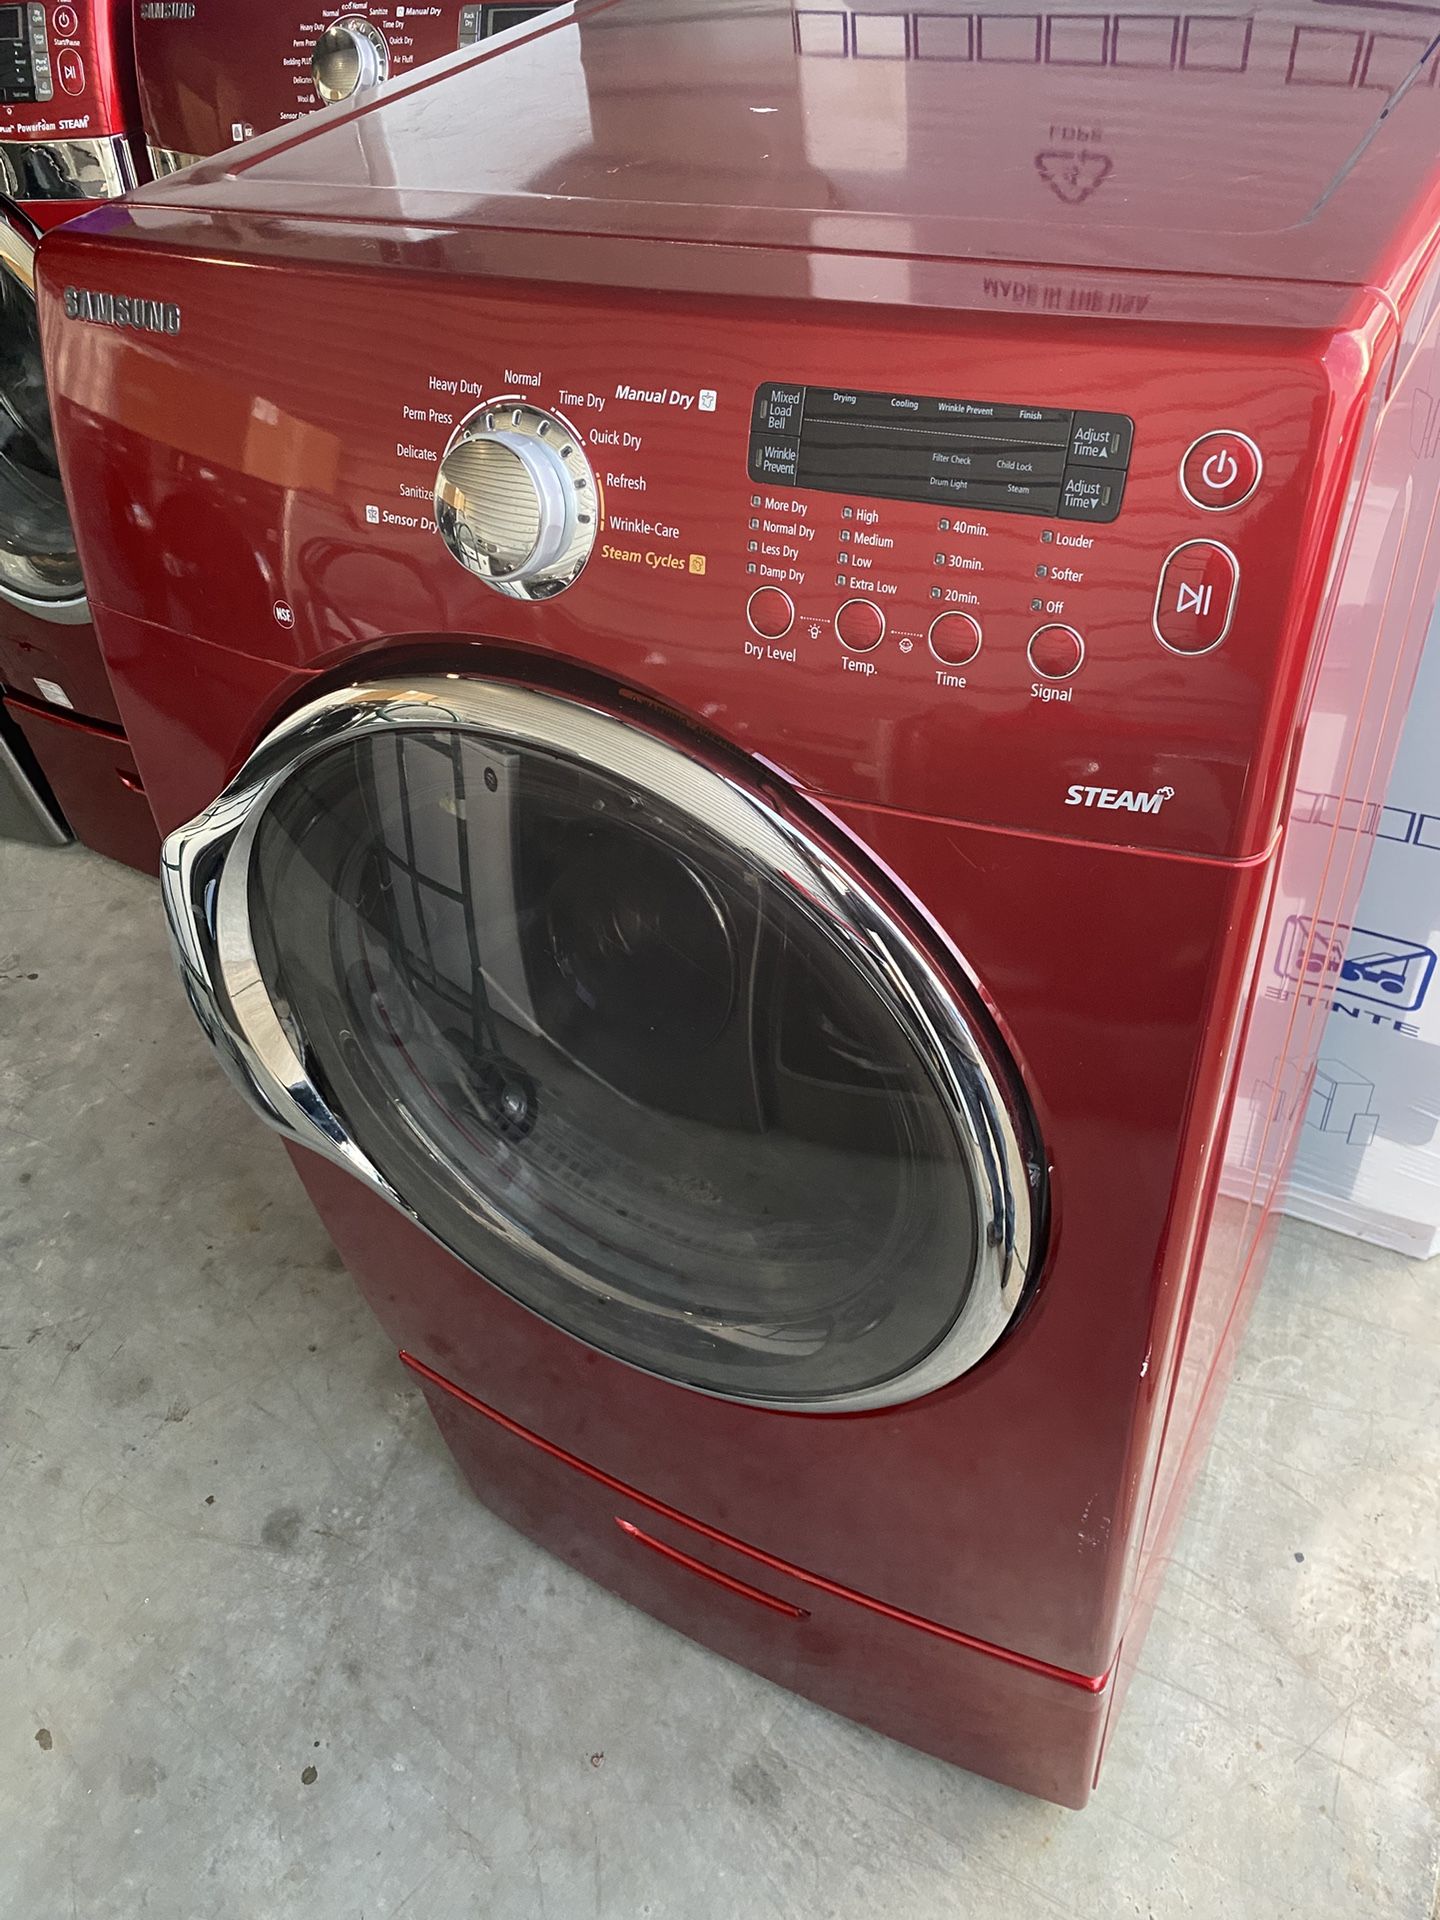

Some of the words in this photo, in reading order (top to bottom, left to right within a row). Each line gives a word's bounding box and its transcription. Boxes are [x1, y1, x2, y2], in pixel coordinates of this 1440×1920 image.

[140, 2, 196, 19] SAMSUNG
[405, 7, 429, 16] Manual
[429, 7, 442, 17] Dry
[395, 20, 405, 29] Dry
[403, 36, 413, 46] Dry
[280, 111, 298, 119] Sensor
[59, 119, 88, 129] STEAM
[64, 286, 181, 336] SAMSUNG
[428, 375, 458, 396] Heavy
[459, 379, 483, 398] Duty
[504, 369, 542, 387] Normal
[559, 390, 585, 407] Time
[586, 393, 606, 412] Dry
[615, 384, 667, 404] Manual
[668, 390, 695, 410] Dry
[771, 390, 800, 404] Mixed
[833, 392, 857, 405] Drying
[890, 397, 919, 411] Cooling
[403, 405, 427, 421] Perm
[428, 409, 453, 425] Press
[769, 403, 793, 417] Load
[938, 402, 964, 414] Wrinkle
[965, 404, 994, 416] Prevent
[1019, 409, 1043, 421] Finish
[768, 416, 786, 430] Bell
[589, 428, 620, 446] Quick
[623, 432, 642, 451] Dry
[1074, 427, 1111, 445] Adjust
[396, 443, 438, 462] Delicates
[764, 446, 797, 461] Wrinkle
[1073, 442, 1099, 457] Time
[763, 460, 796, 476] Prevent
[932, 453, 950, 463] Filter
[950, 454, 972, 466] Check
[996, 460, 1015, 470] Child
[1016, 461, 1033, 472] Lock
[606, 472, 647, 491] Refresh
[930, 477, 949, 487] Drum
[950, 479, 969, 490] Light
[1007, 484, 1030, 495] Steam
[1065, 480, 1101, 498] Adjust
[399, 482, 434, 501] Sanitize
[764, 497, 789, 512] More
[791, 500, 808, 516] Dry
[1064, 494, 1090, 509] Time
[382, 511, 418, 528] Sensor
[420, 516, 439, 534] Dry
[856, 508, 879, 525] High
[609, 516, 680, 539] Wrinkle-Care
[763, 520, 797, 536] Normal
[799, 525, 815, 541] Dry
[953, 520, 989, 537] 40min.
[853, 531, 894, 549] Medium
[1056, 532, 1095, 549] Louder
[601, 544, 642, 563] Steam
[645, 551, 686, 570] Cycles
[761, 542, 781, 556] Less
[782, 545, 799, 561] Dry
[851, 554, 873, 569] Low
[948, 554, 985, 571] 30min.
[759, 564, 787, 580] Damp
[788, 569, 805, 585] Dry
[1050, 566, 1084, 583] Softer
[849, 578, 874, 592] Extra
[876, 580, 898, 595] Low
[944, 589, 980, 605] 20min.
[275, 606, 293, 623] NSF
[1046, 601, 1064, 615] Off
[744, 641, 764, 660] Dry
[767, 645, 797, 663] Level
[841, 656, 878, 677] Temp.
[935, 671, 967, 688] Time
[1030, 683, 1073, 703] Signal
[1064, 784, 1165, 815] STEAM
